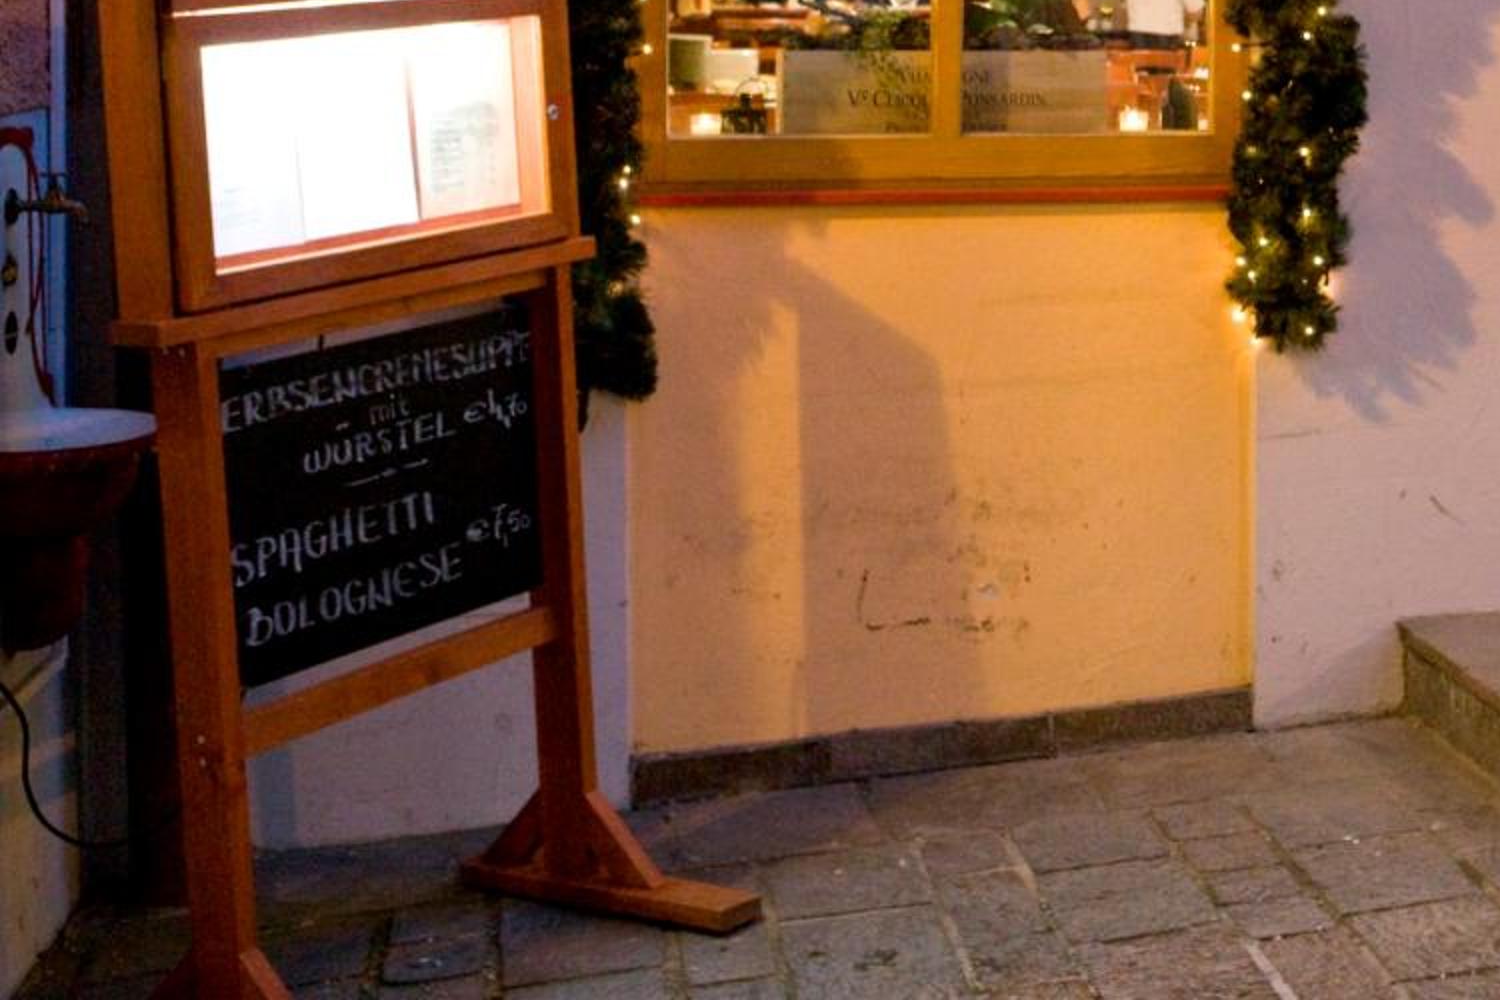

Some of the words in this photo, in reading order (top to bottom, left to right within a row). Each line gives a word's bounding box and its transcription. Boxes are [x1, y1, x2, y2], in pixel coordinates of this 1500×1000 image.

[370, 394, 411, 424] mit
[232, 492, 436, 588] SPAGHETTI
[246, 543, 463, 647] BOLOGNESE
